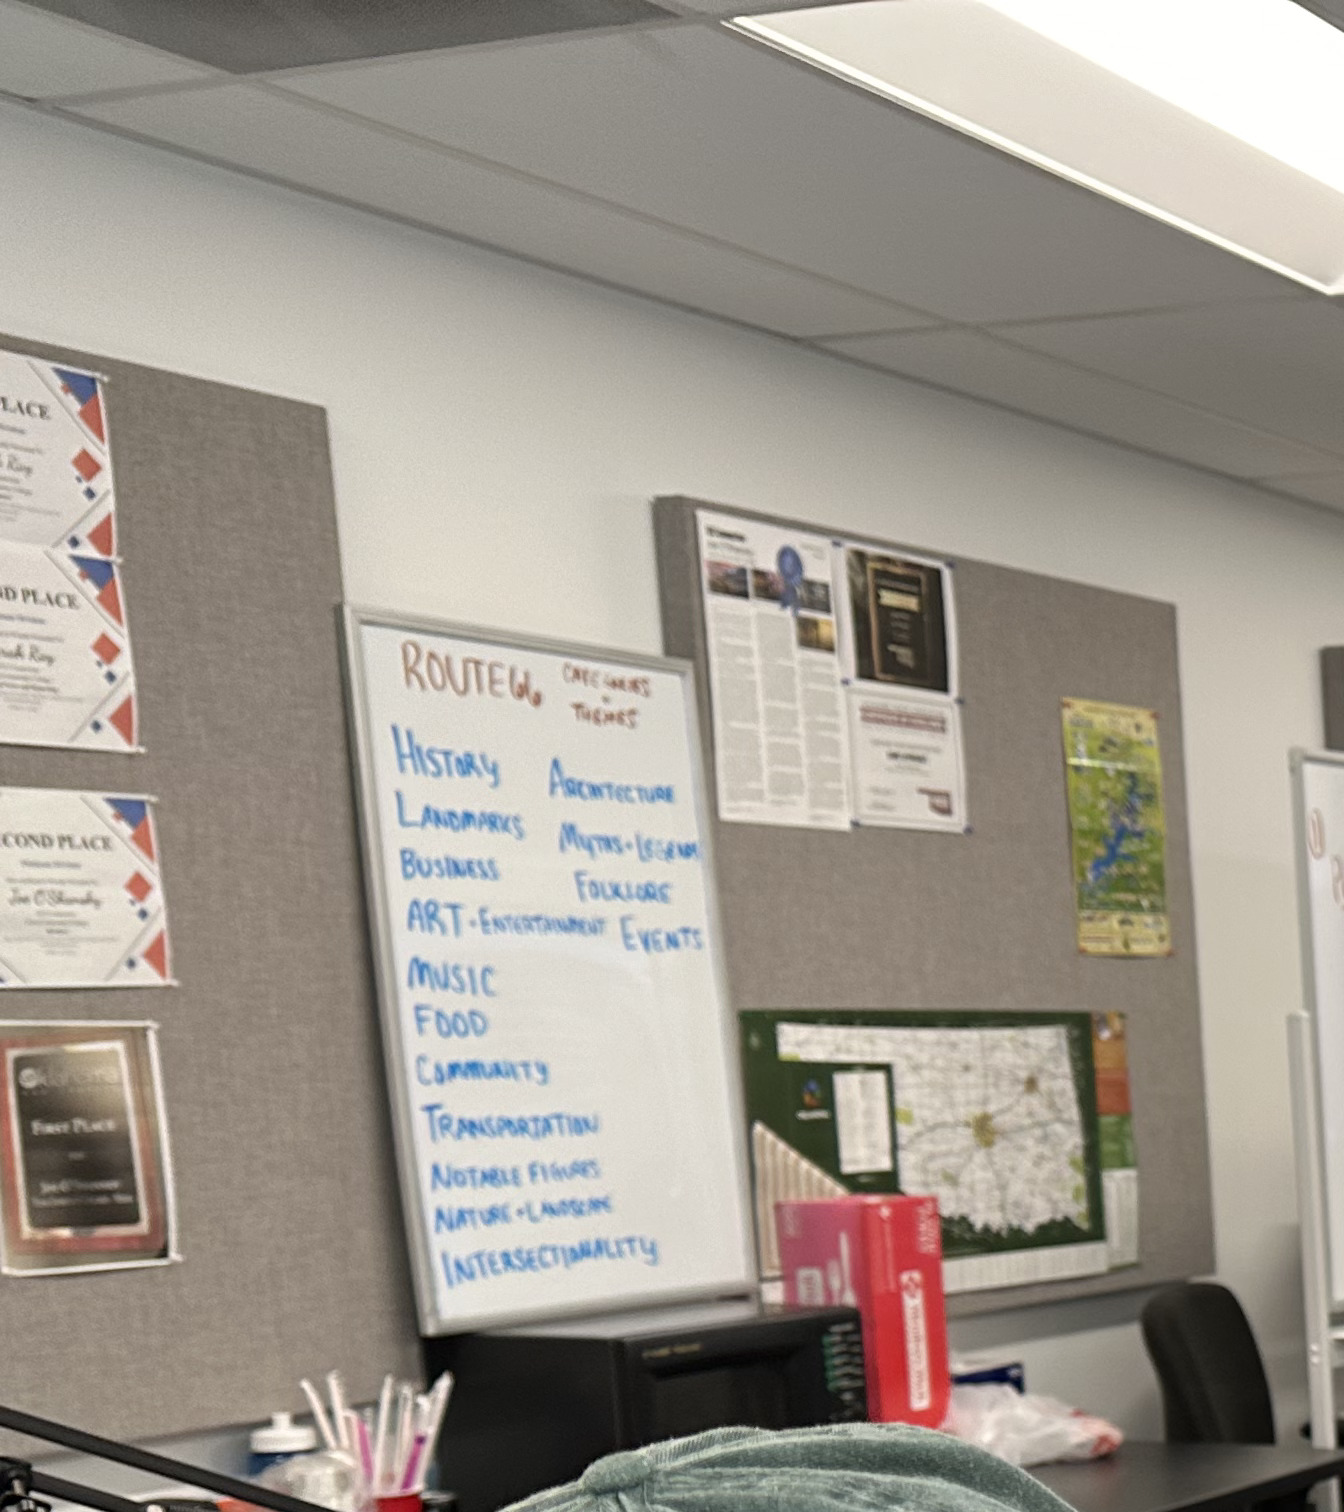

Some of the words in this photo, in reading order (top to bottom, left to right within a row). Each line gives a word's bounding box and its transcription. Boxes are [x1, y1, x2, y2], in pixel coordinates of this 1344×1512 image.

[0, 396, 51, 420] LACE
[20, 587, 80, 610] PLACE
[402, 639, 504, 698] ROUTE
[392, 723, 500, 790] HISTORY
[396, 790, 526, 841] LANDMARKS
[0, 832, 53, 852] COND
[58, 834, 114, 852] PLACE
[400, 847, 501, 882] BUSINESS
[573, 869, 673, 904] FOLKLORE
[406, 899, 464, 938] ART
[620, 915, 704, 954] EVENTS
[407, 956, 498, 998] MUSIC
[413, 1003, 490, 1040] FOOD
[415, 1054, 550, 1087] COMMUNITY
[420, 1103, 601, 1144] TRANSPORTATION
[430, 1162, 522, 1192] NOTABLE
[434, 1205, 512, 1234] NATURE
[441, 1235, 660, 1290] INTERSECTIONALITY
